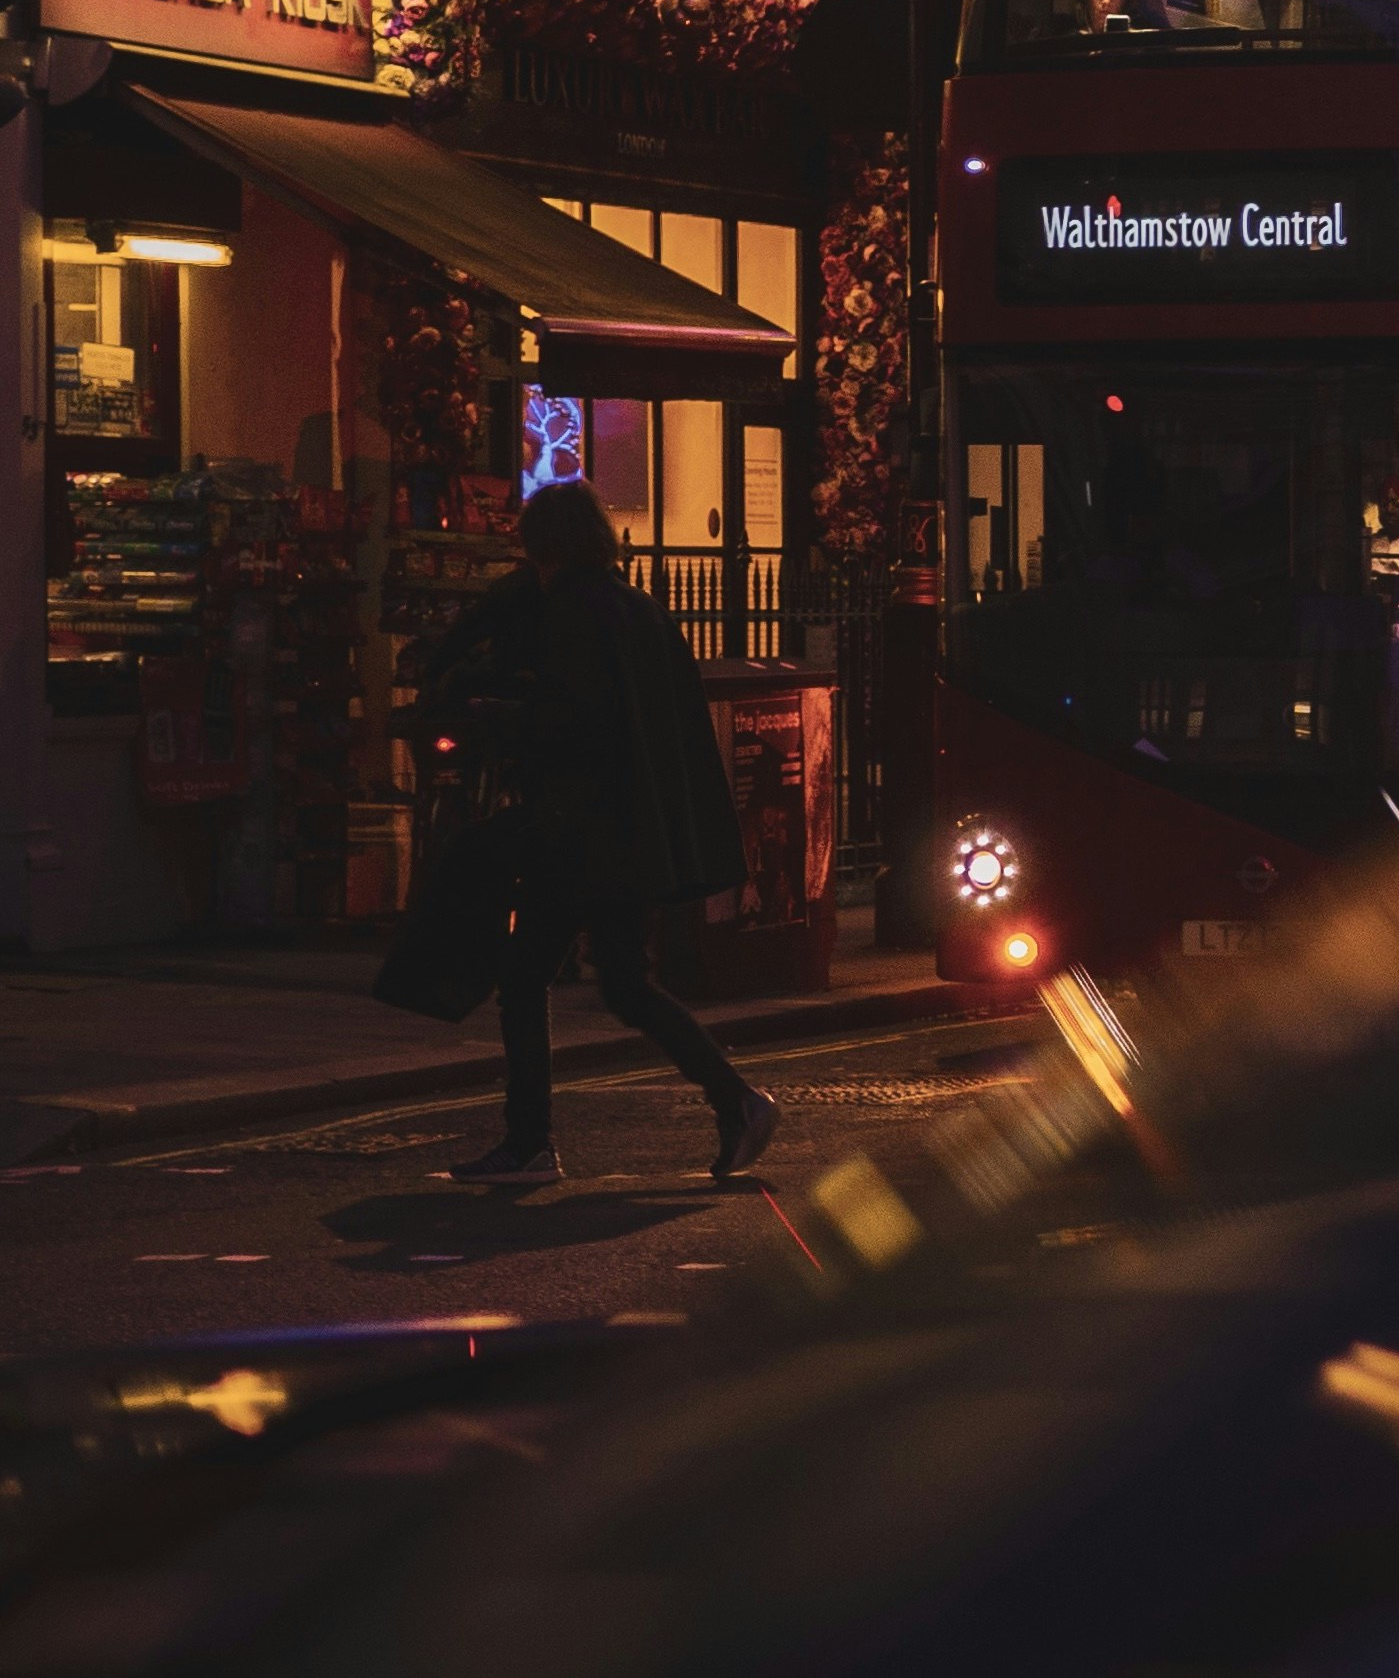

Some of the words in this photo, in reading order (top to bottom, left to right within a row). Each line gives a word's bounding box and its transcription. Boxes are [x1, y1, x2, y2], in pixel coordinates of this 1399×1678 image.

[616, 132, 667, 159] LONDON
[1041, 204, 1232, 248] Walthamstow
[1241, 202, 1348, 247] Central
[734, 711, 754, 734] the
